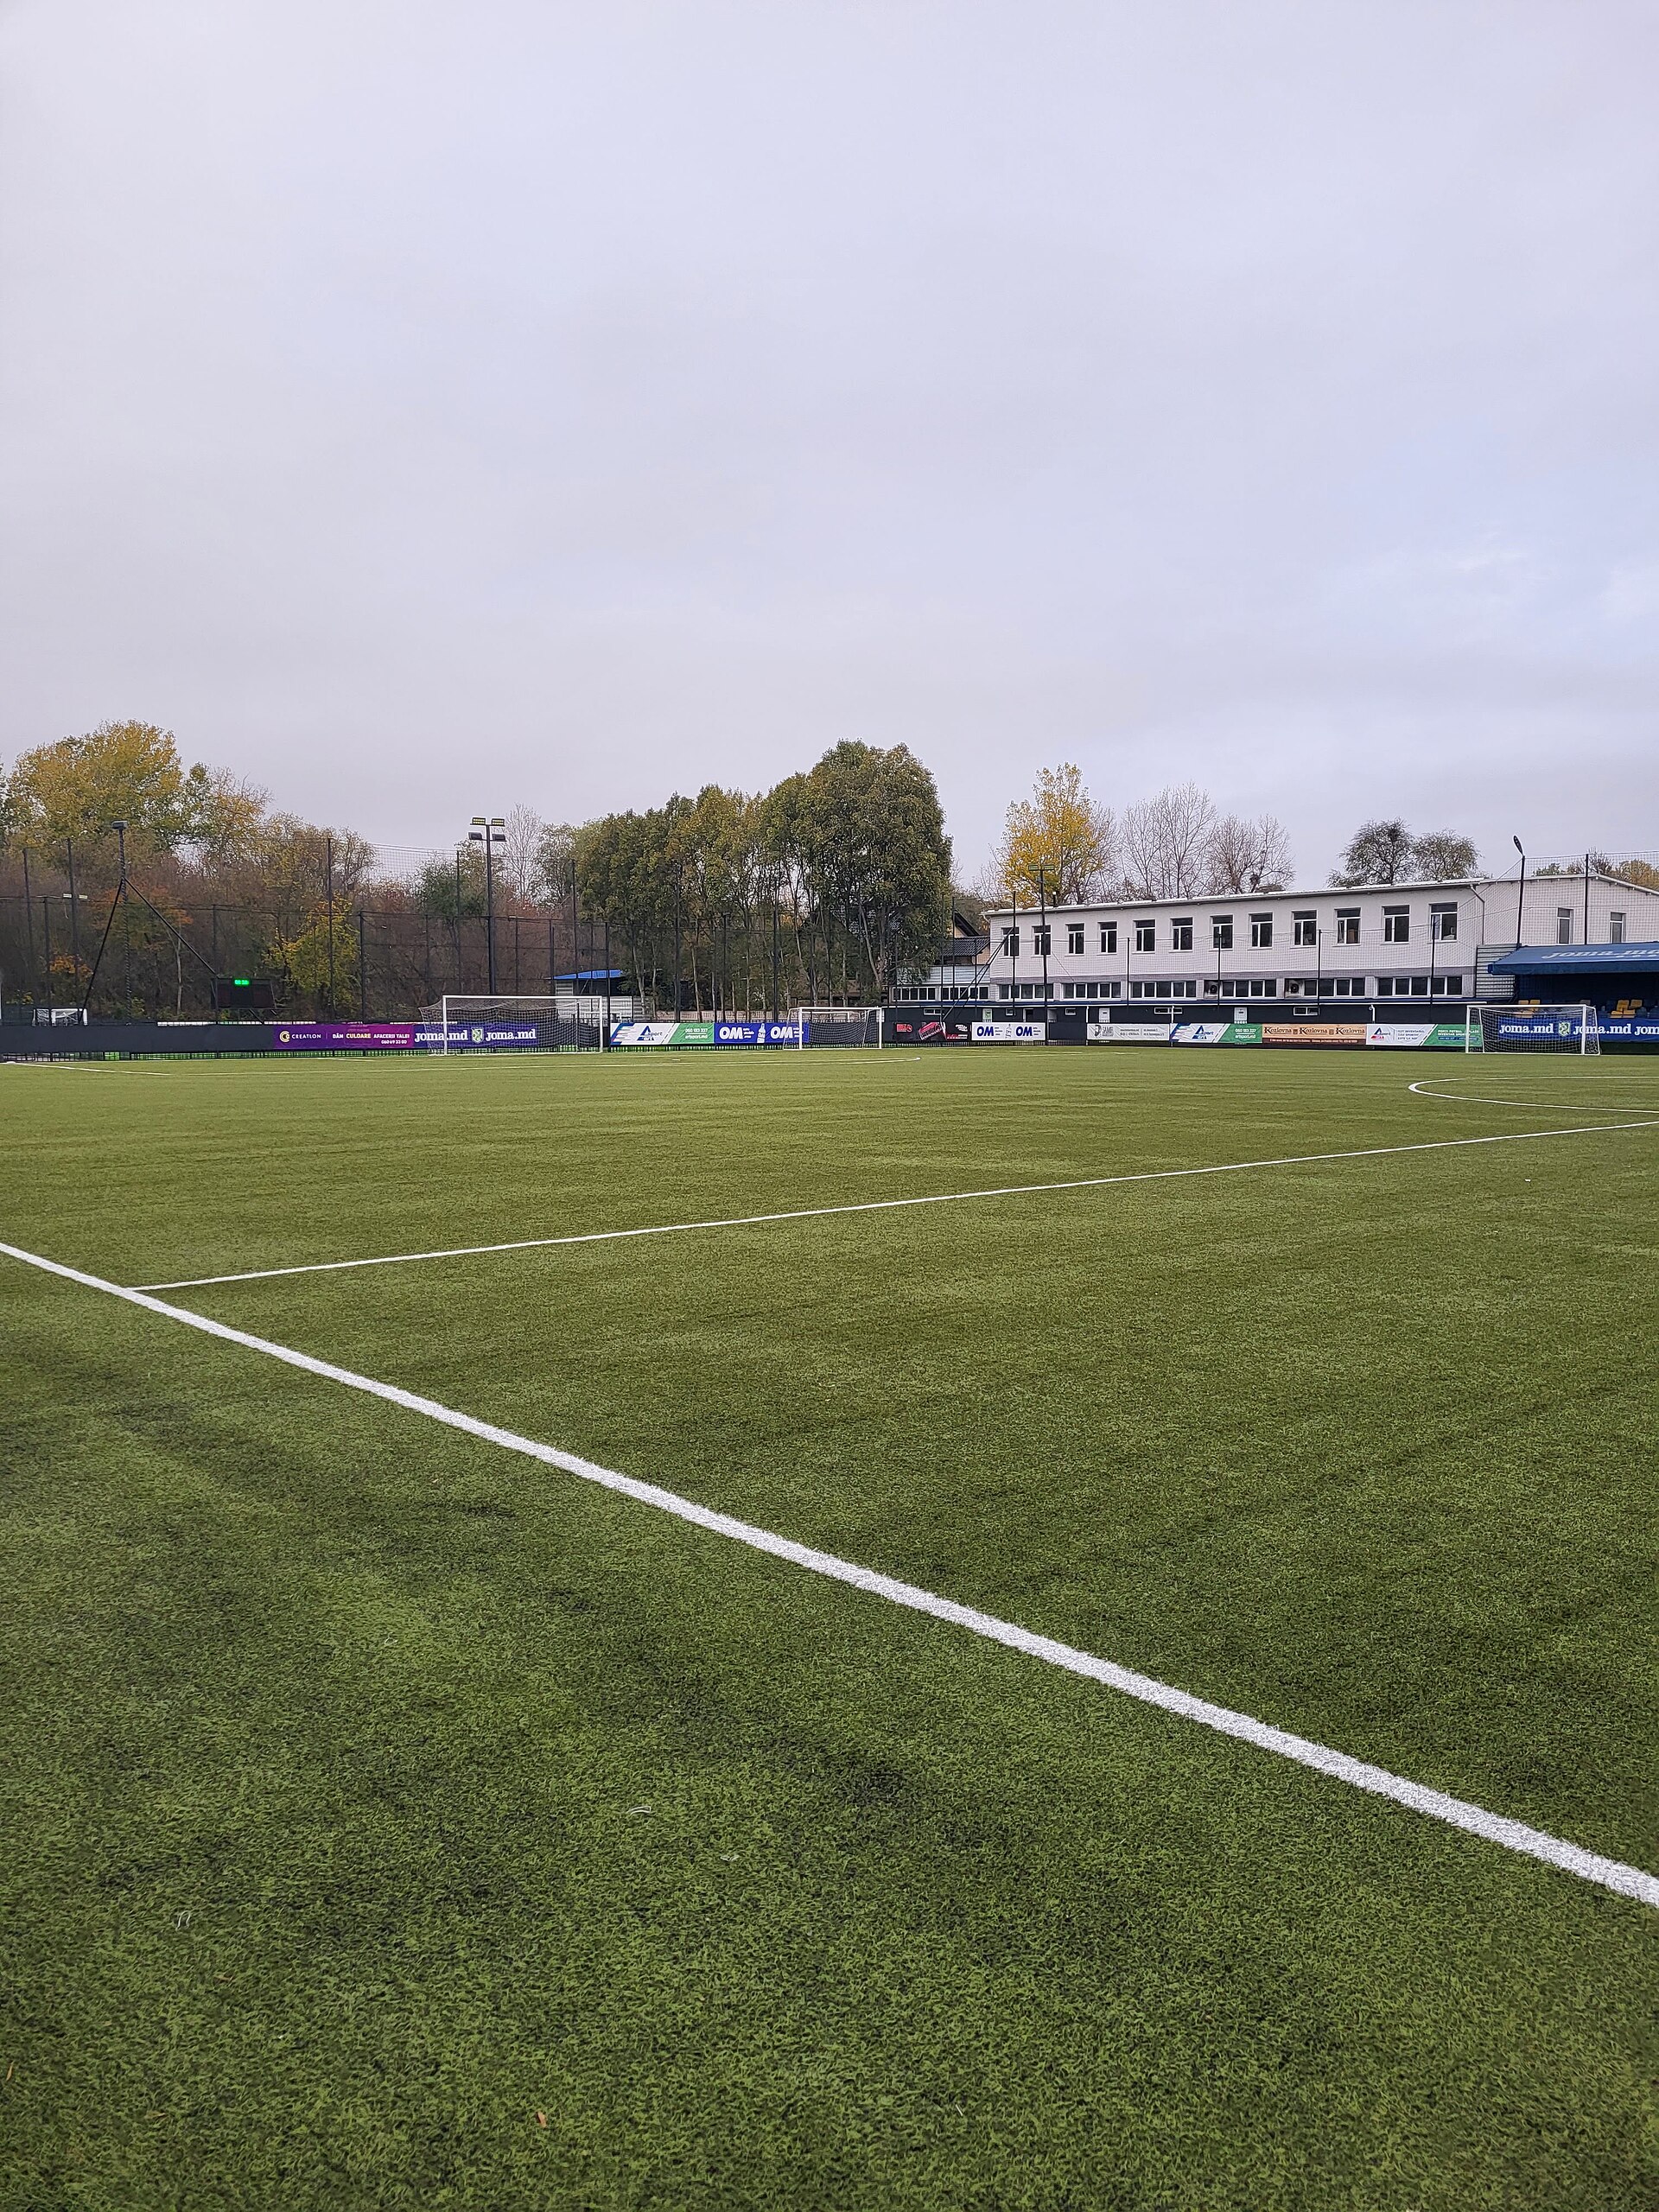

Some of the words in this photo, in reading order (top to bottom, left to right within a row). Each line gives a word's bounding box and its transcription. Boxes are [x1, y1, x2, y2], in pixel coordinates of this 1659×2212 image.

[719, 1027, 743, 1039] OM
[770, 1027, 793, 1039] OM
[976, 1026, 994, 1037] OM
[1015, 1026, 1033, 1037] OM
[1264, 1027, 1292, 1035] Kozlovna
[1299, 1027, 1327, 1035] Kozlovna
[1335, 1027, 1365, 1035] Kozlovna
[1499, 1022, 1554, 1034] joma.md
[415, 1030, 468, 1042] joma.md
[486, 1029, 537, 1041] joma.md
